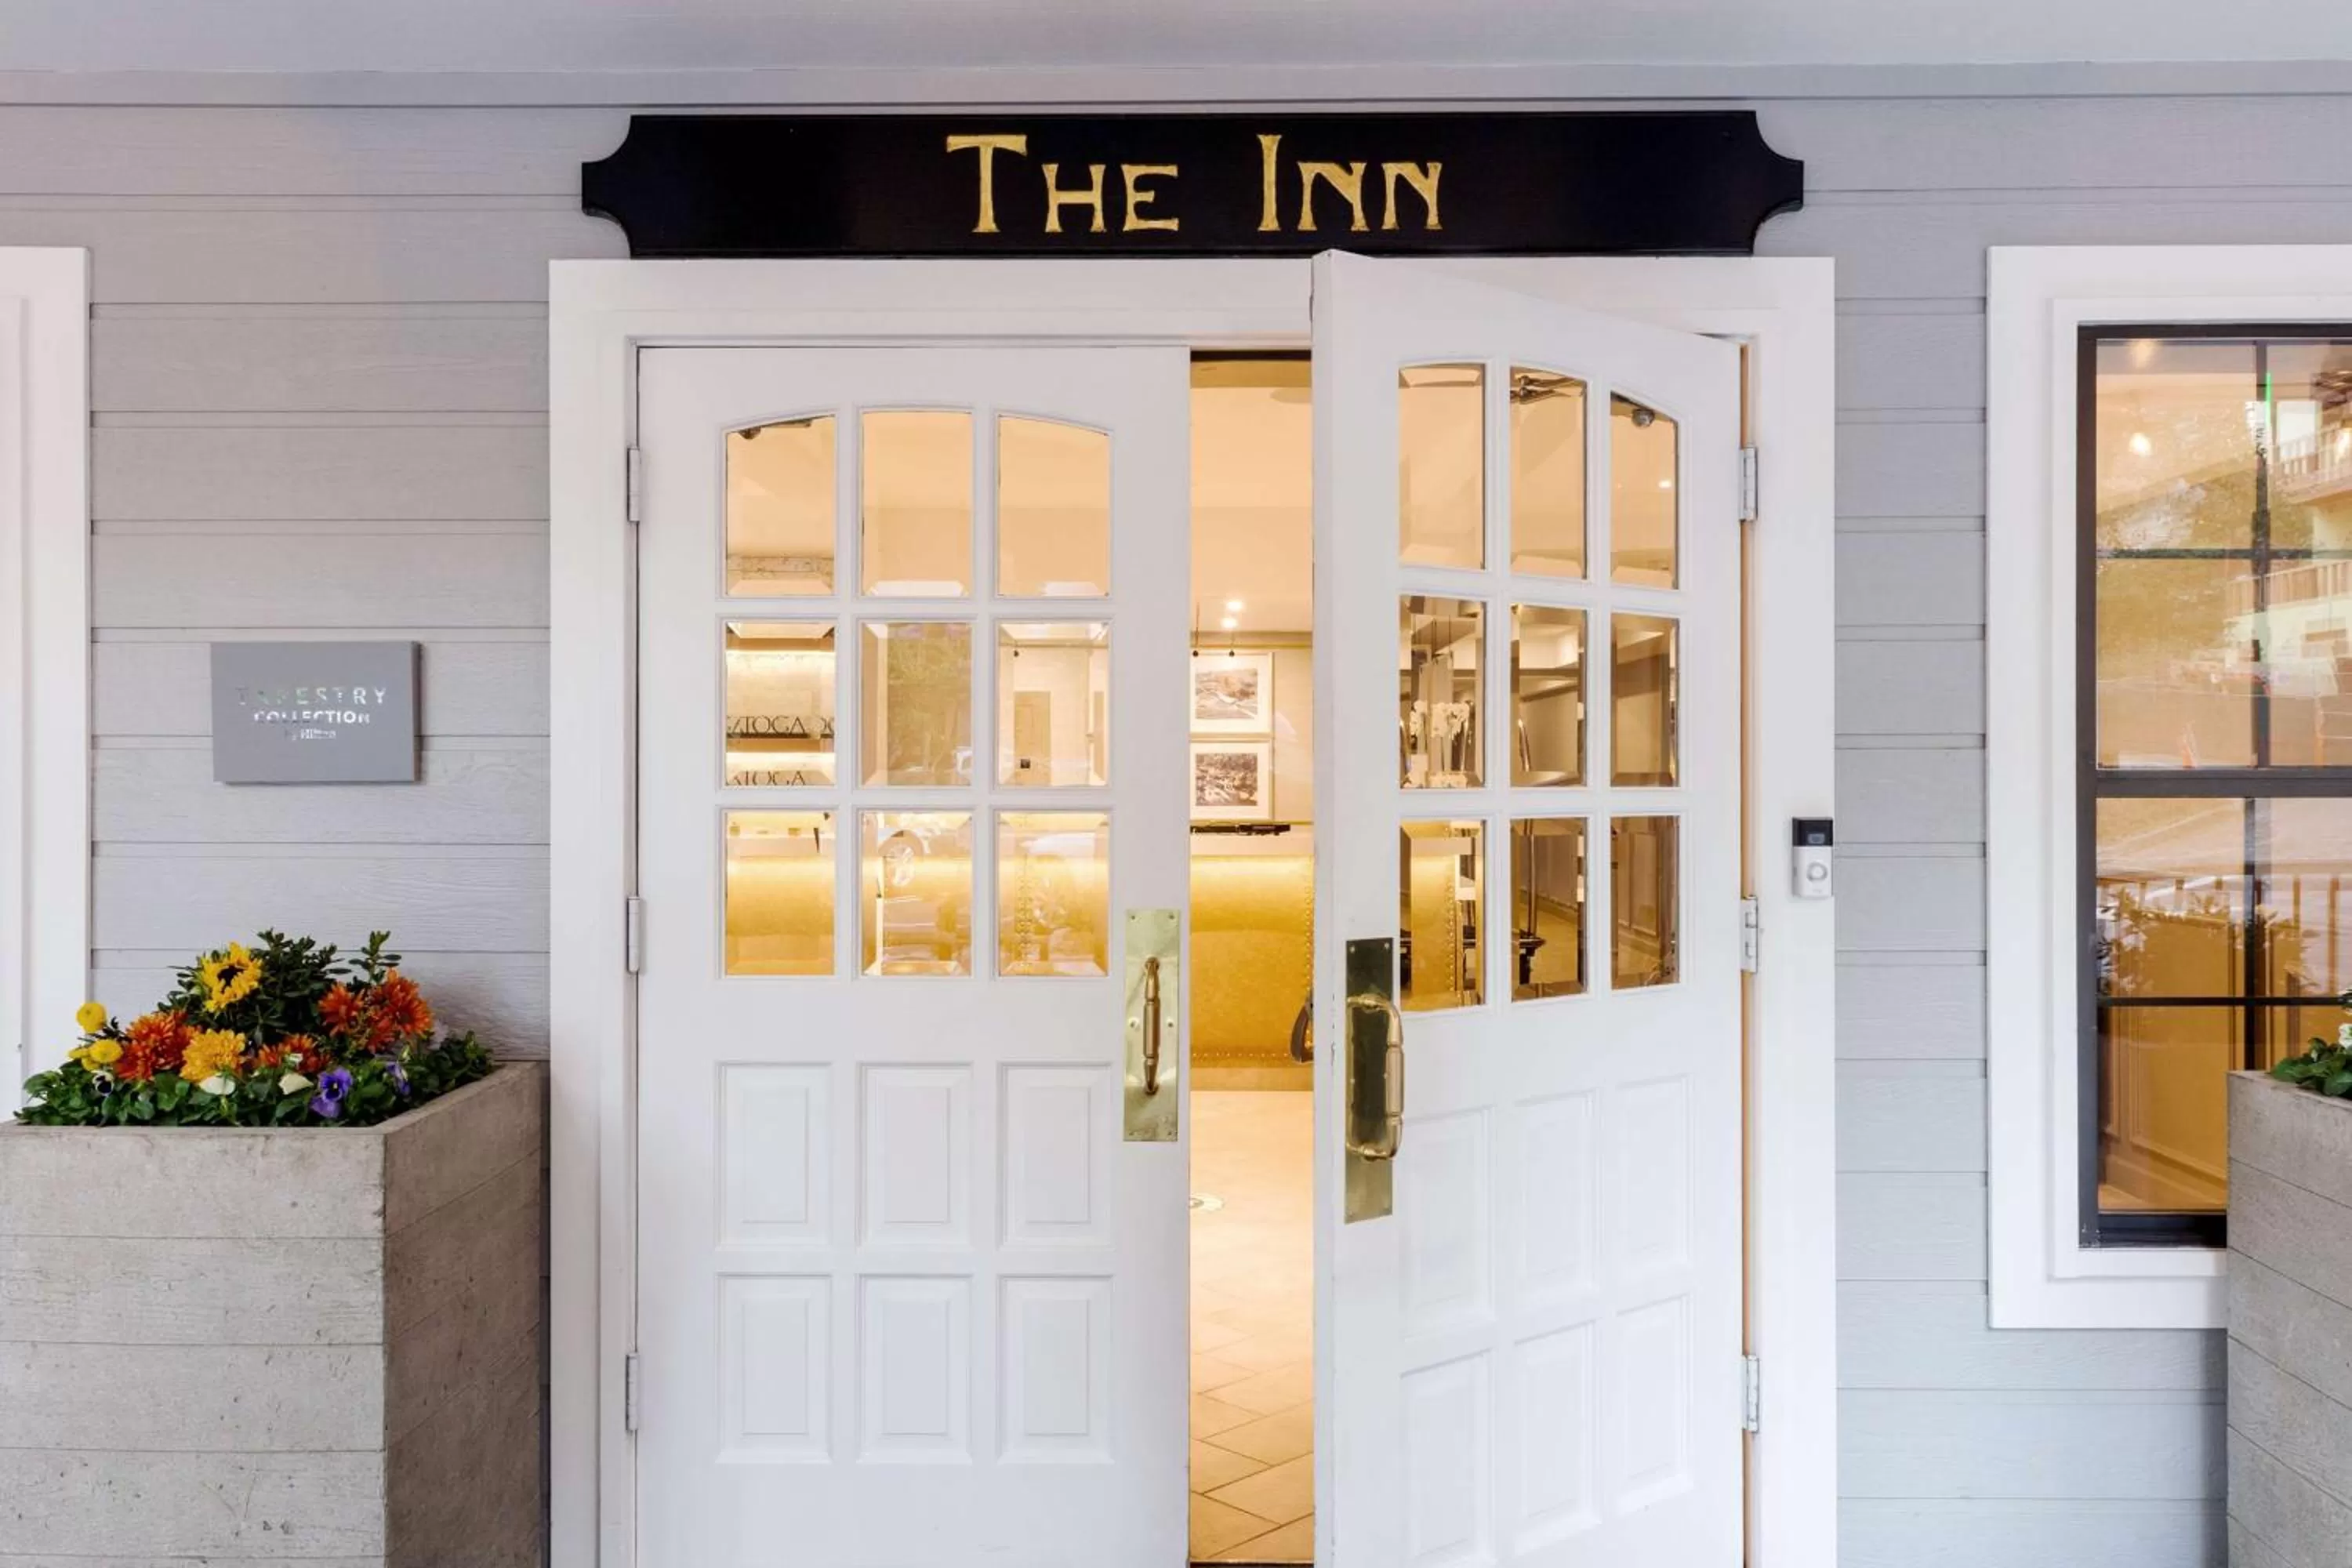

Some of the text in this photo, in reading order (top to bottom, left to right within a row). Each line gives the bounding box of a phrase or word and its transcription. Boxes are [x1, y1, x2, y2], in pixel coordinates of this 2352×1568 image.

[946, 134, 1443, 233] THE INN
[253, 710, 371, 724] COLLECTION
